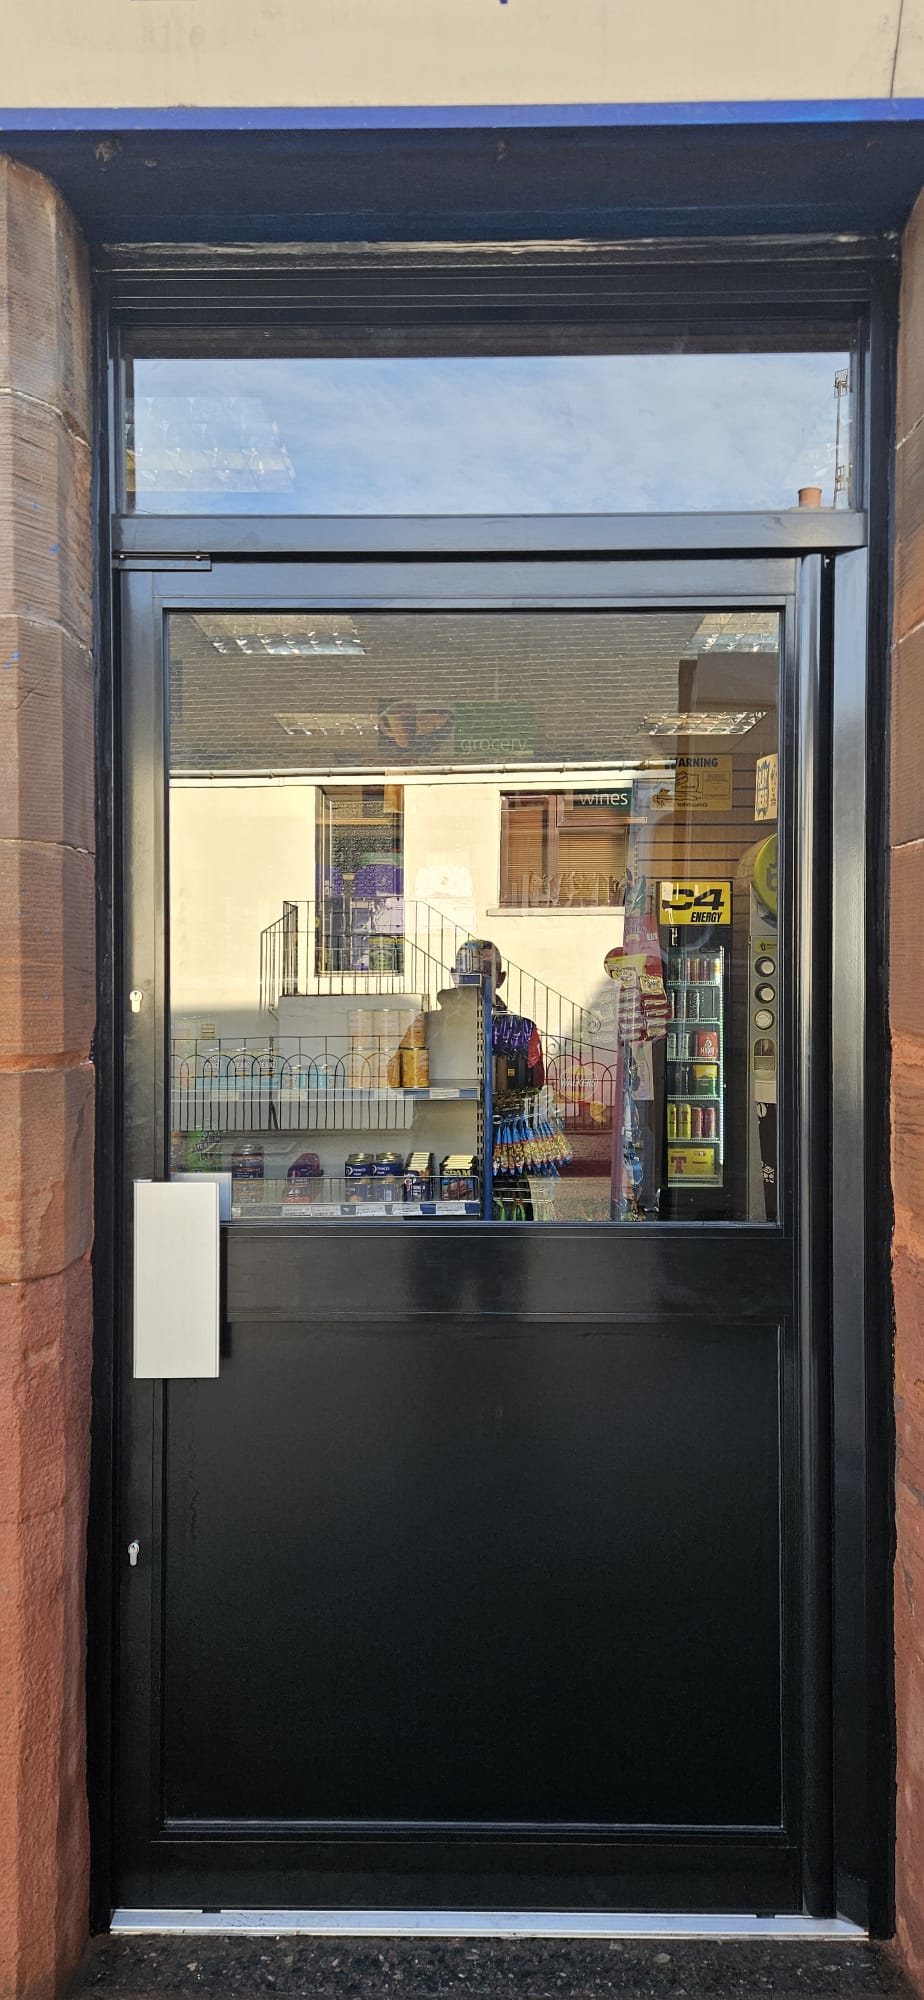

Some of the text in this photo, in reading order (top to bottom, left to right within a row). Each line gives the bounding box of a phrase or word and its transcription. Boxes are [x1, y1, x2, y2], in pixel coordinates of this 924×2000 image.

[461, 738, 528, 756] grocery
[579, 790, 629, 806] wines
[661, 888, 725, 911] C4
[690, 911, 724, 924] ENERGY
